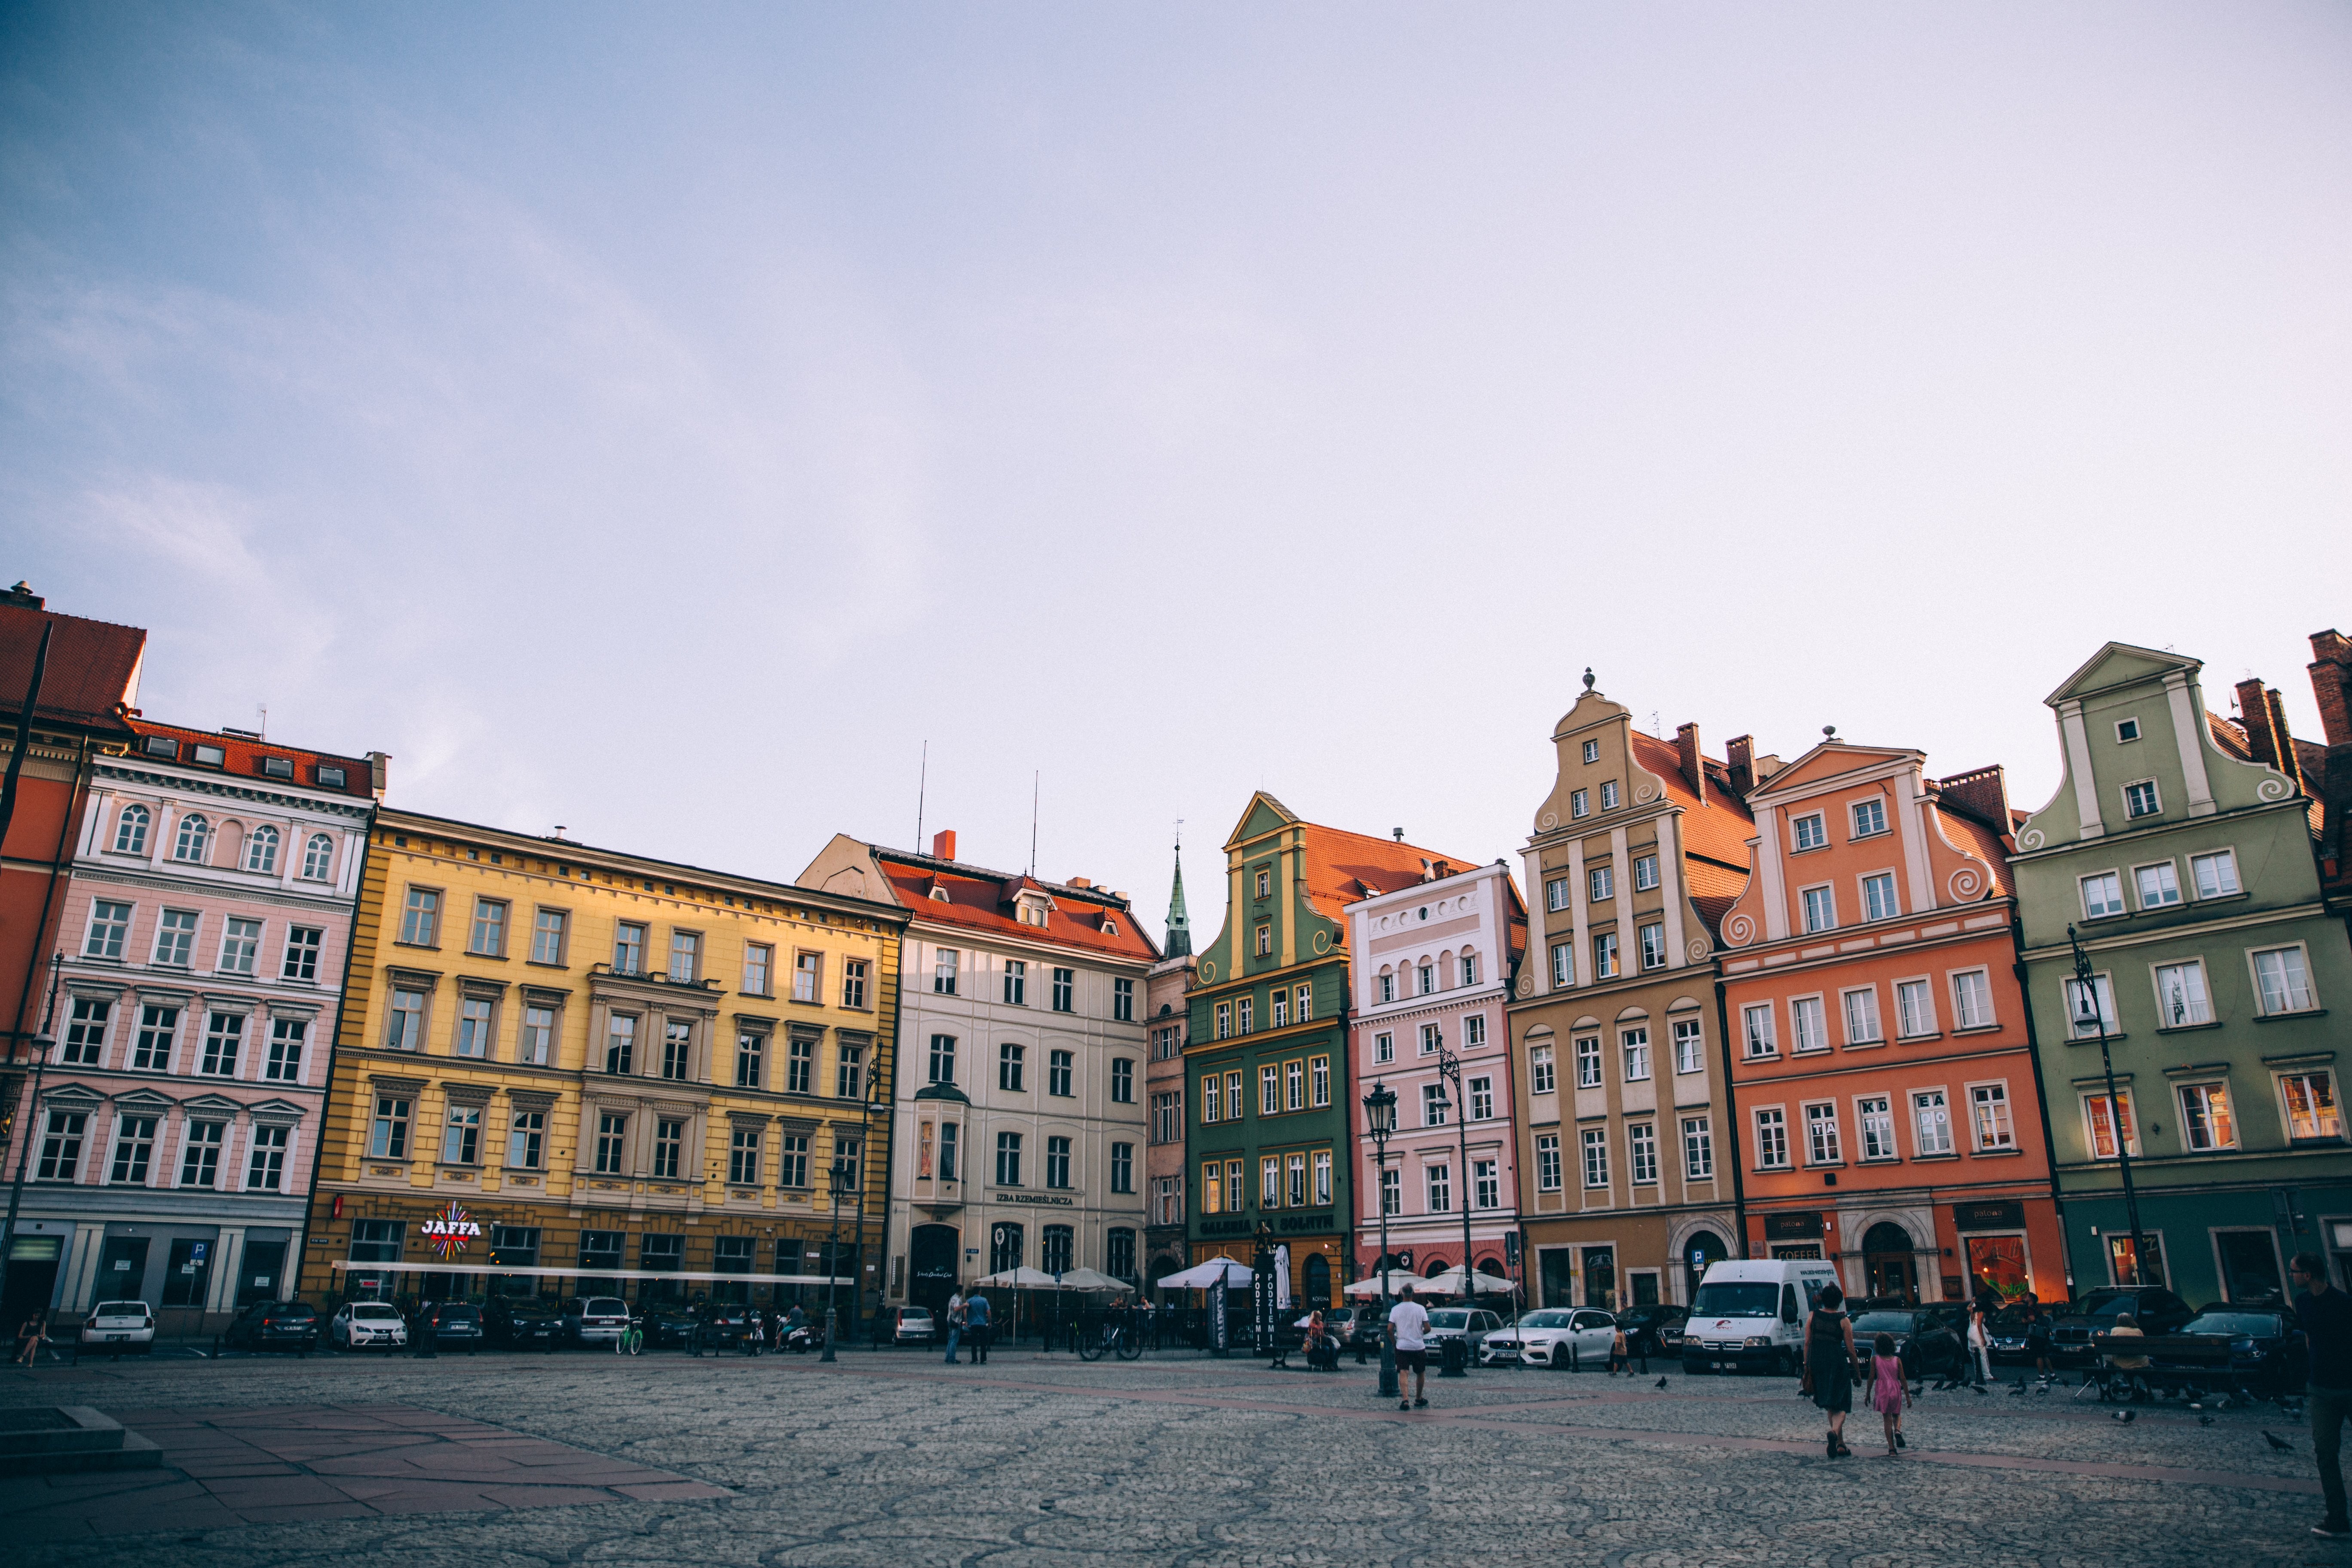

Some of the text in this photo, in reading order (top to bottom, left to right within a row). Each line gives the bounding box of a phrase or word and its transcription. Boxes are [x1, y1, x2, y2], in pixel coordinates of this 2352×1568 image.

[996, 1194, 1073, 1205] IZBA RZEMIEŚLNICZA
[421, 1220, 481, 1236] JAFFA
[1200, 1220, 1252, 1234] GALERIA
[1280, 1214, 1334, 1231] SOLNYM
[1695, 1251, 1702, 1262] P
[1779, 1250, 1819, 1259] COFFEE
